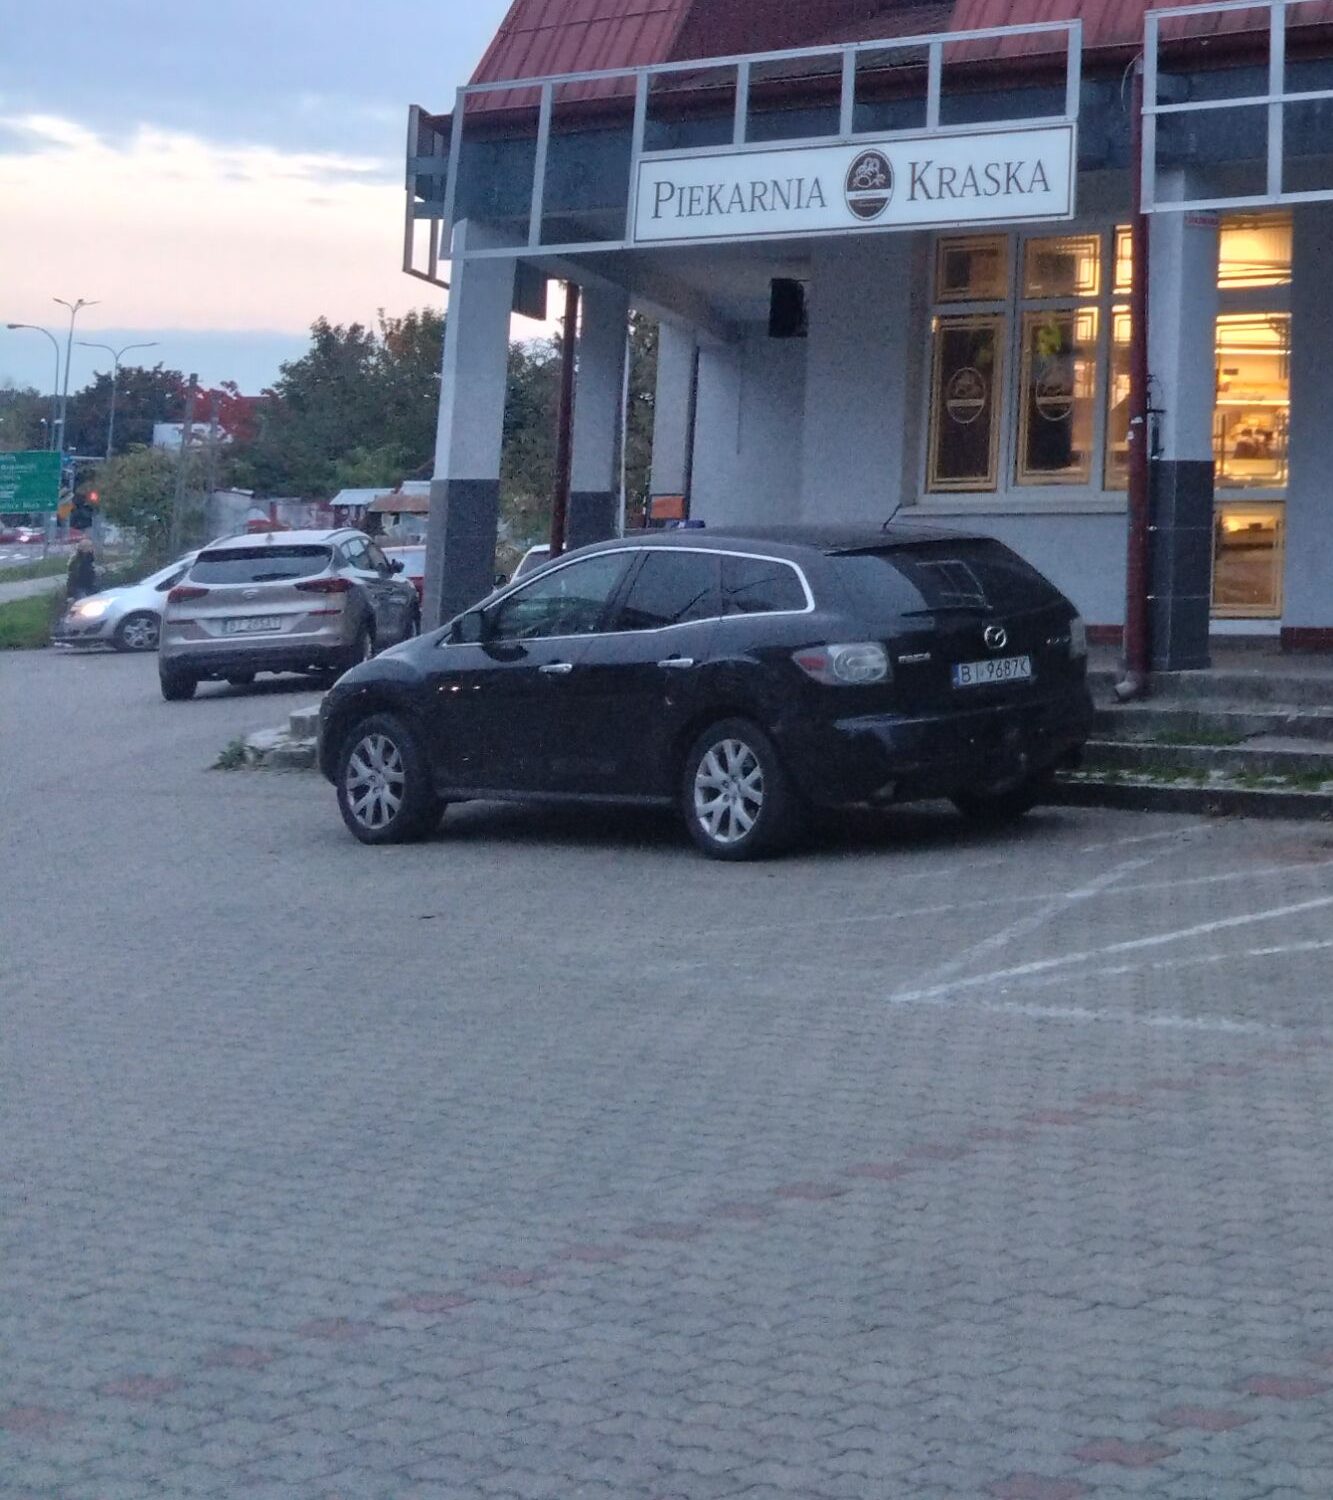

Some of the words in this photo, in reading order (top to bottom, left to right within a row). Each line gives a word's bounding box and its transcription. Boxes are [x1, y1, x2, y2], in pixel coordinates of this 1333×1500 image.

[651, 176, 828, 219] PIEKARNIA
[906, 159, 1052, 202] KRASKA
[961, 664, 979, 684] BI
